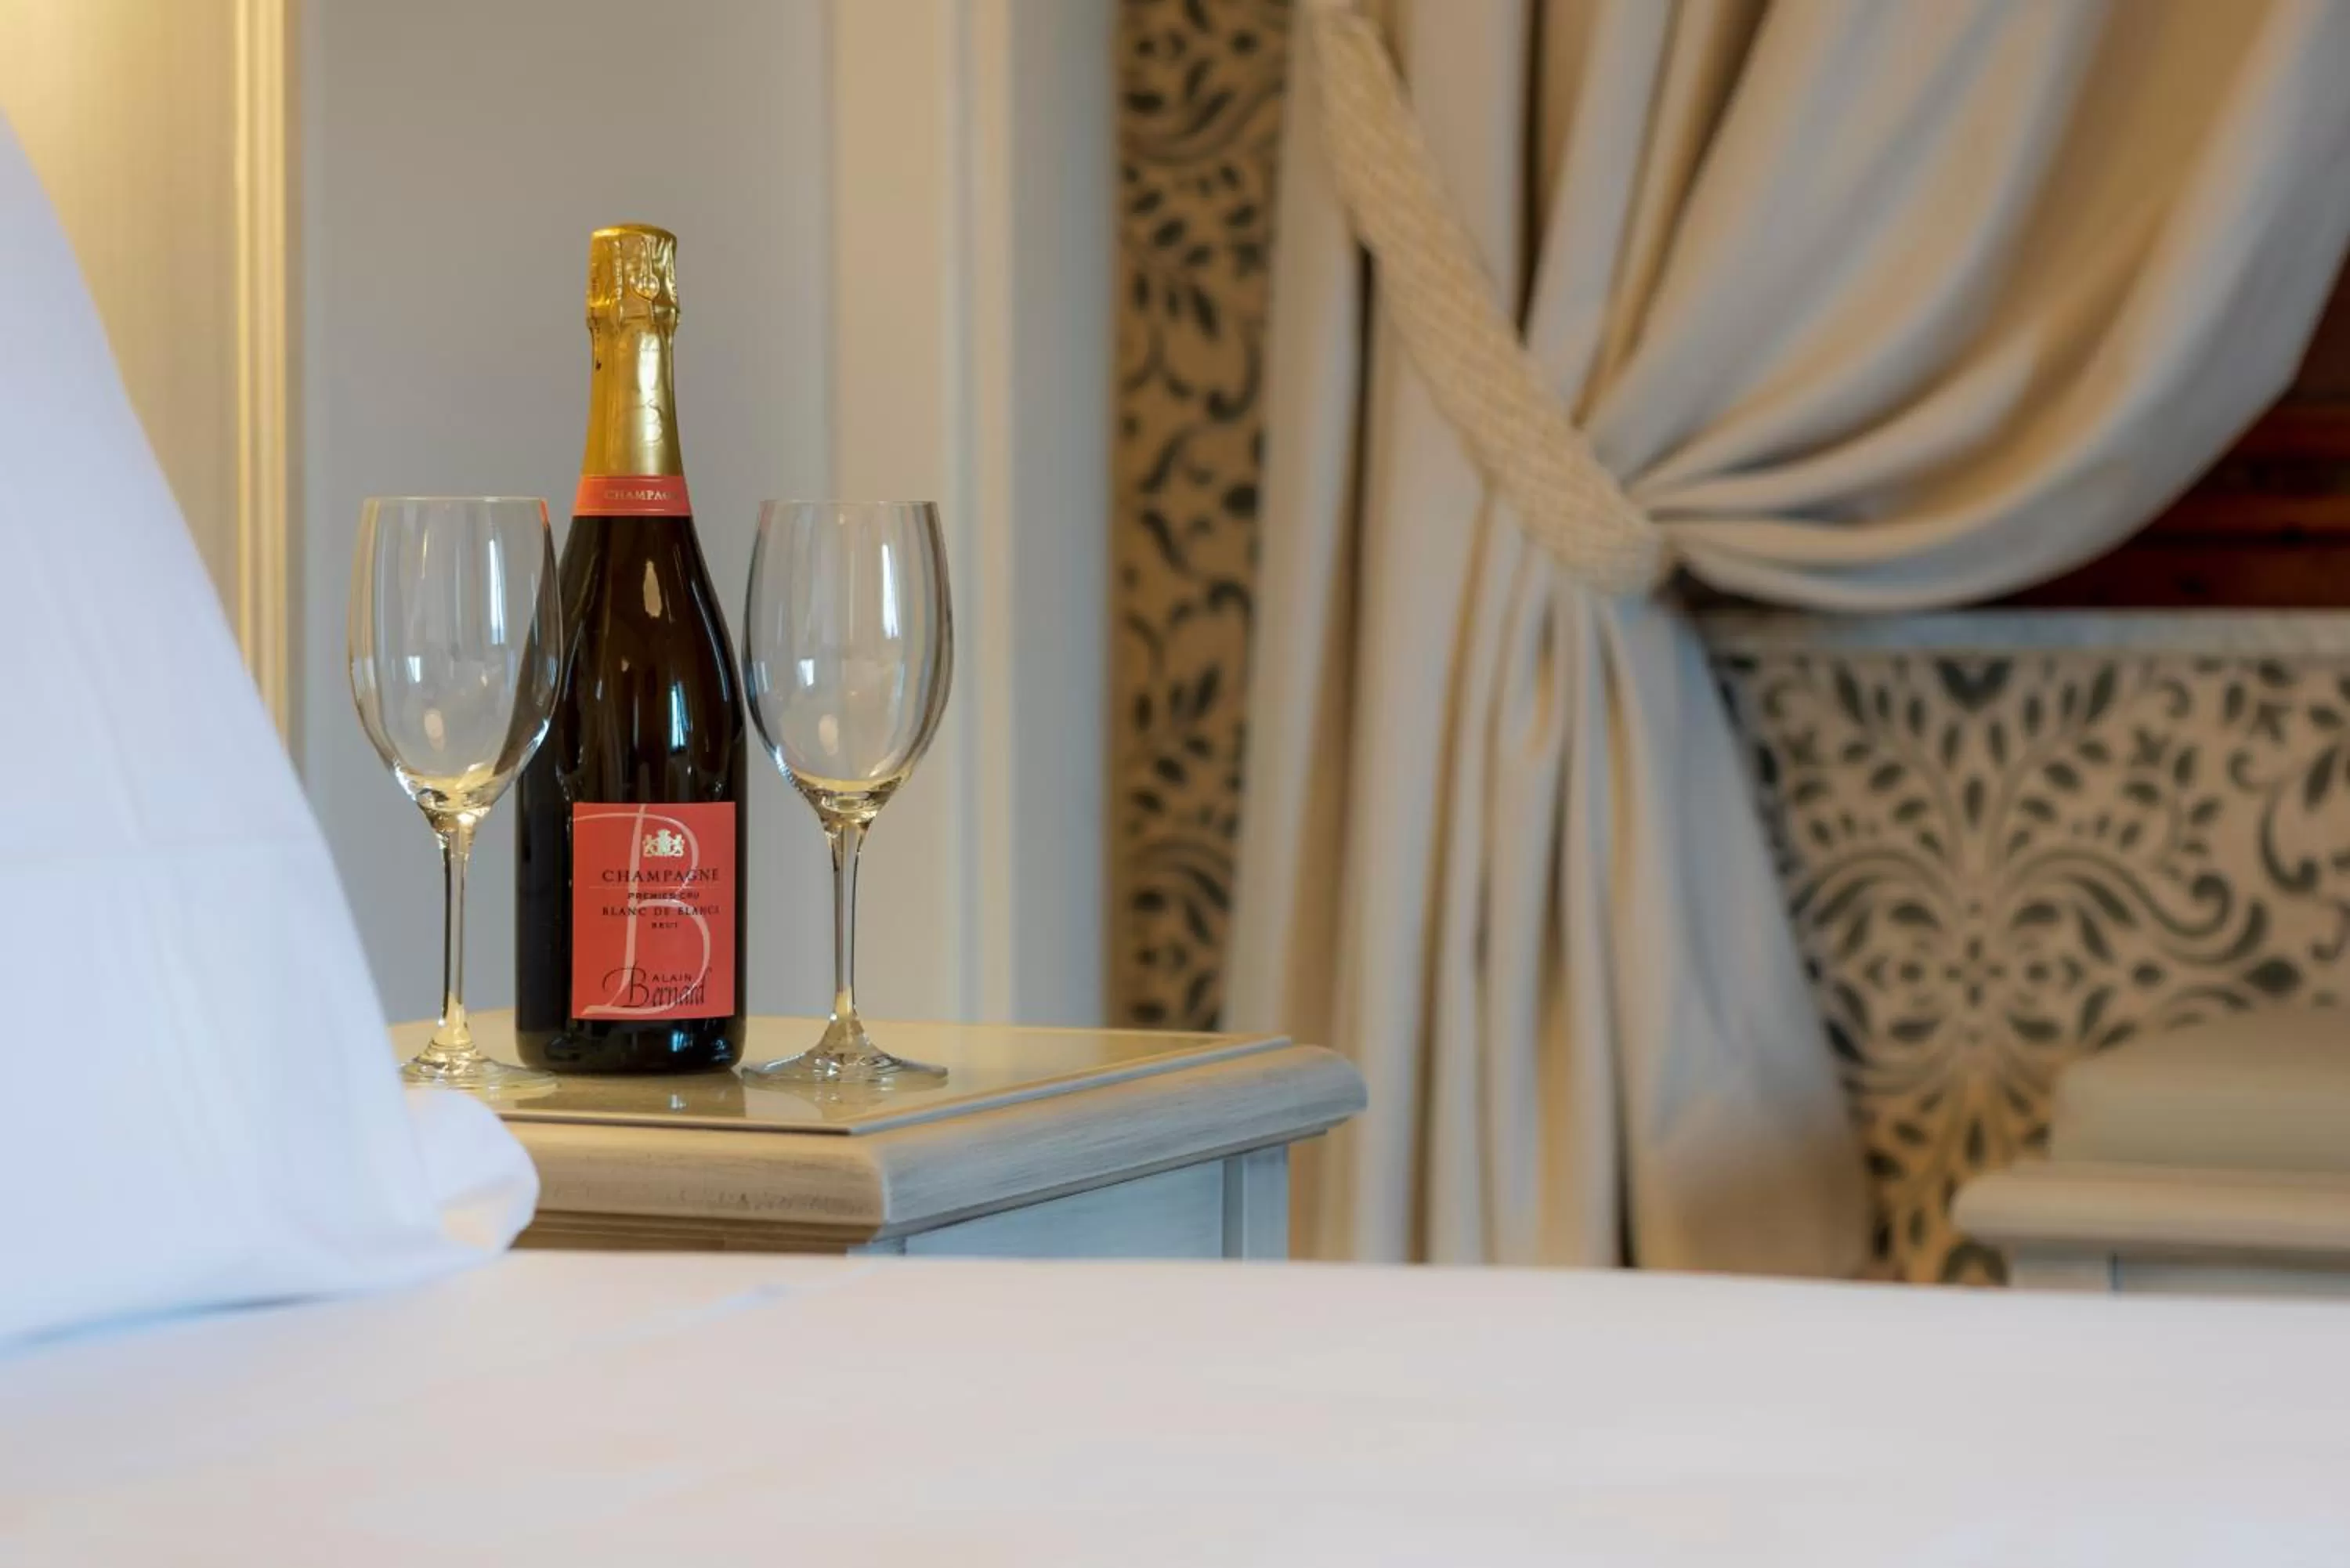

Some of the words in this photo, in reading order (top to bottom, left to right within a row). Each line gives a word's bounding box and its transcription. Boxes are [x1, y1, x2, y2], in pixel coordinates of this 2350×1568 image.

[602, 868, 720, 883] CHAMPAGNE
[602, 906, 646, 916] BLANC
[654, 906, 670, 916] DE
[652, 973, 692, 983] ALAIN
